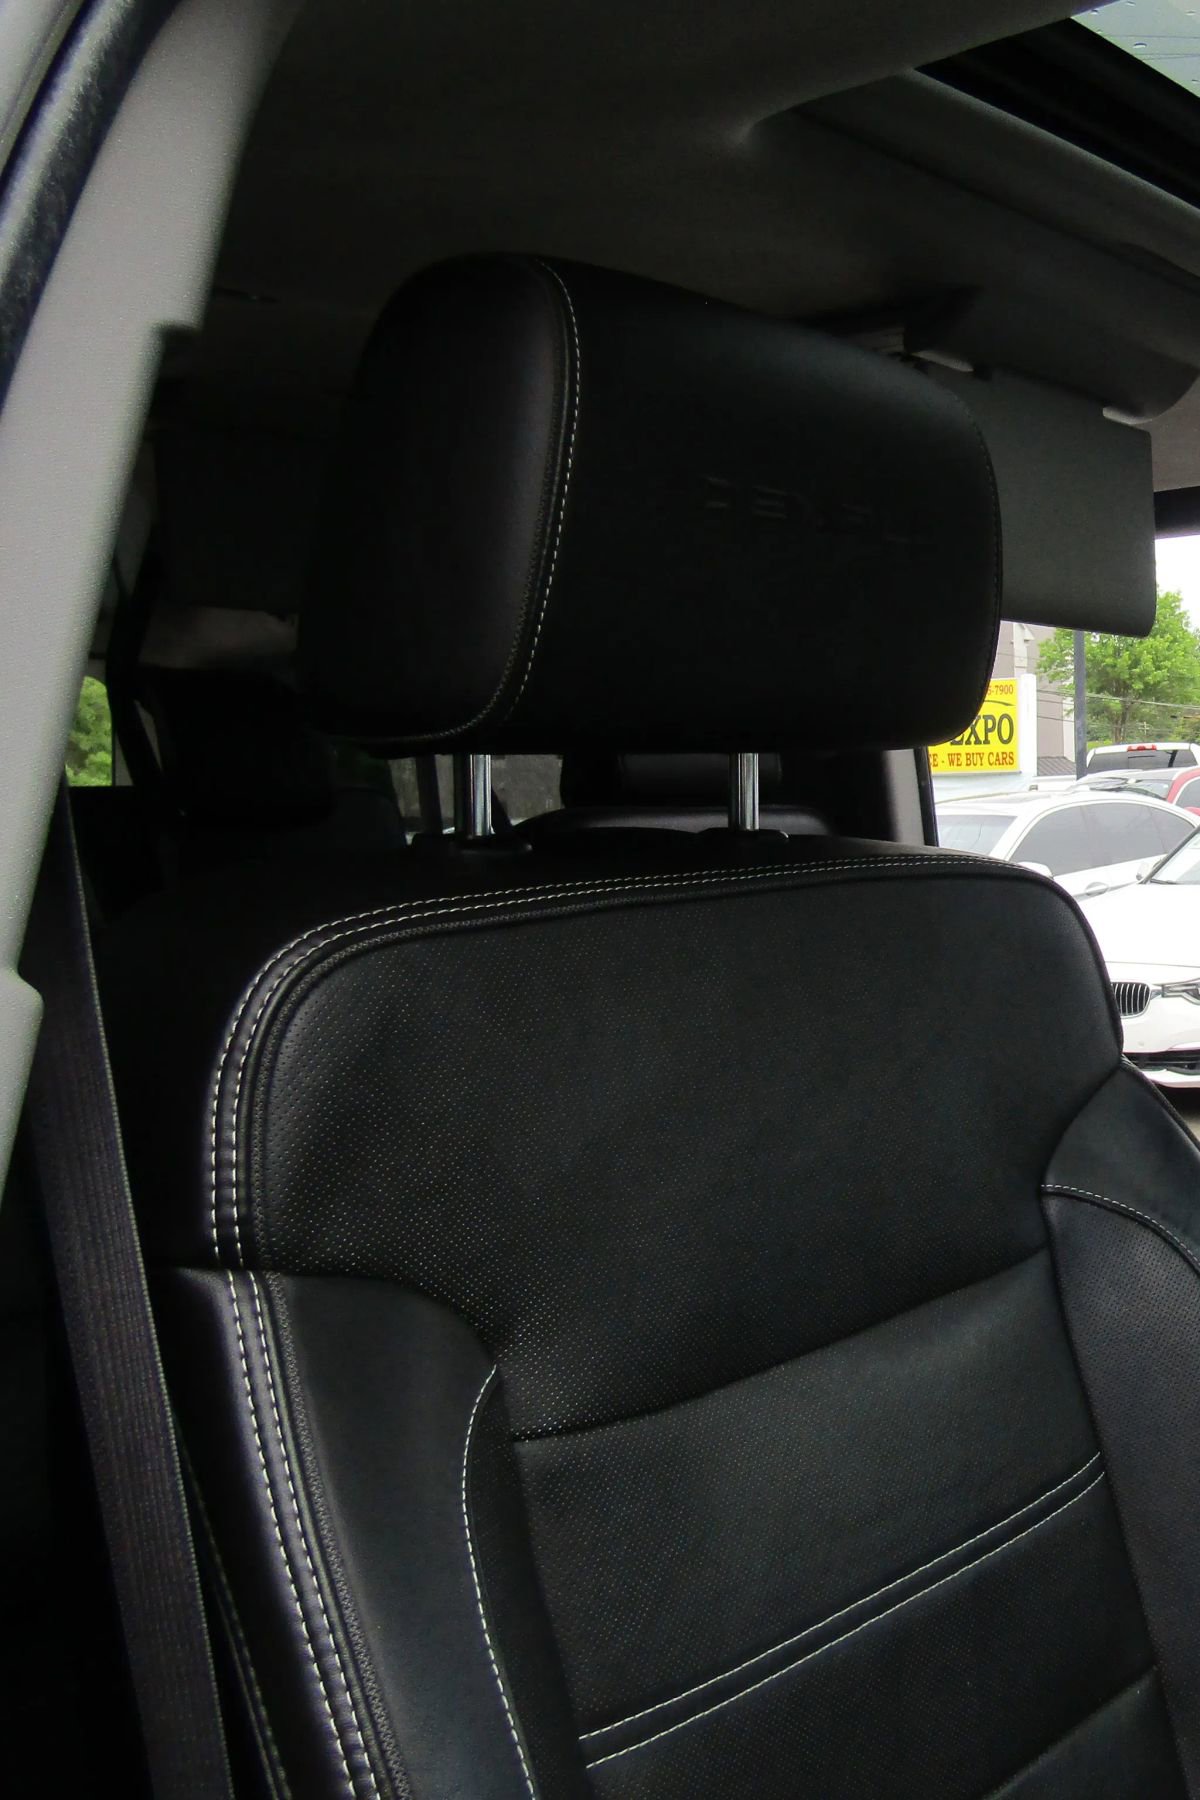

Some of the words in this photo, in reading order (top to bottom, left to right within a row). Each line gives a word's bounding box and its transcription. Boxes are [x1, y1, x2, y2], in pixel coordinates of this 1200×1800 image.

[947, 753, 962, 767] WE
[965, 752, 985, 767] BUY
[987, 751, 1015, 766] CARS
